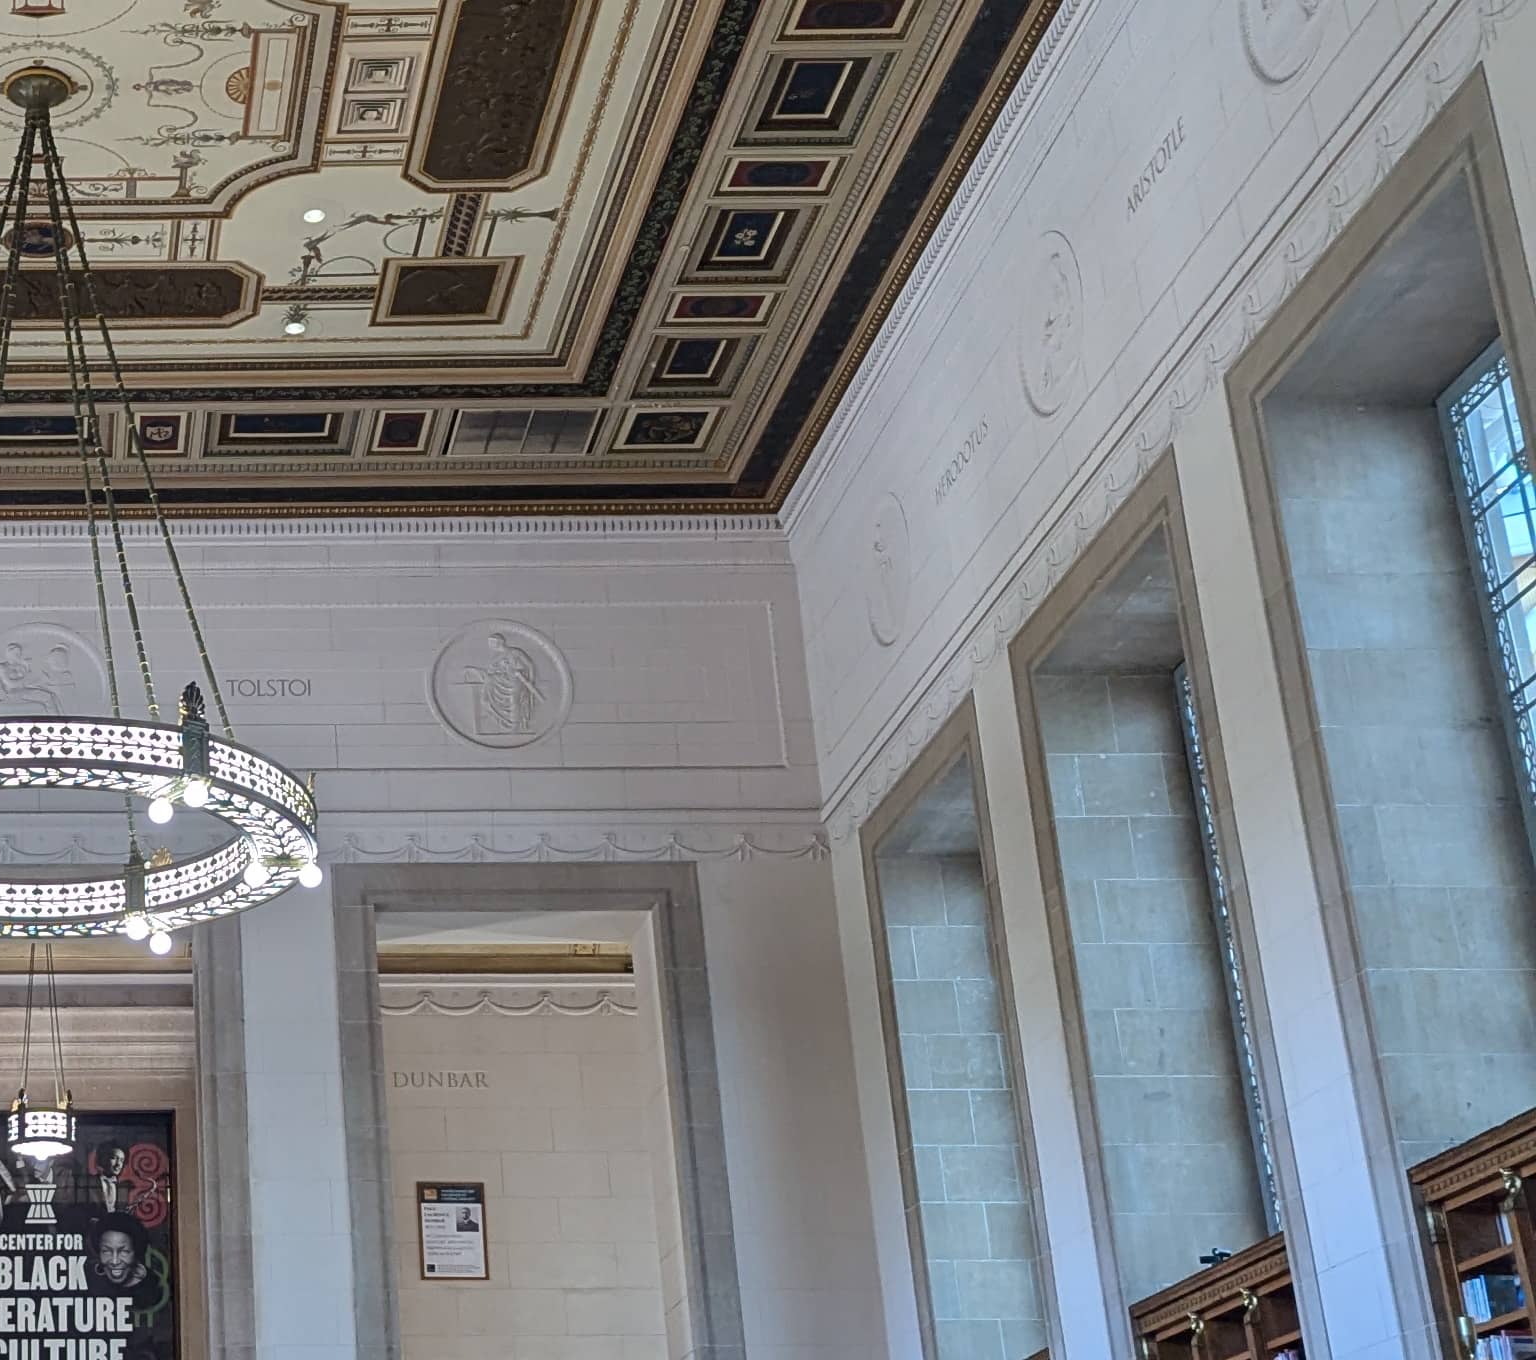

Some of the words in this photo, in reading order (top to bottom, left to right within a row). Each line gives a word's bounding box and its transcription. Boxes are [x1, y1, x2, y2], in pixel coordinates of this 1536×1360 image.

[1127, 115, 1183, 222] ARISTOTLE
[935, 414, 988, 505] HERODOTUS
[226, 679, 312, 697] TOLSTOI
[393, 1071, 489, 1089] DUNBAR
[0, 1234, 53, 1251] CENTER
[56, 1234, 83, 1251] FOR
